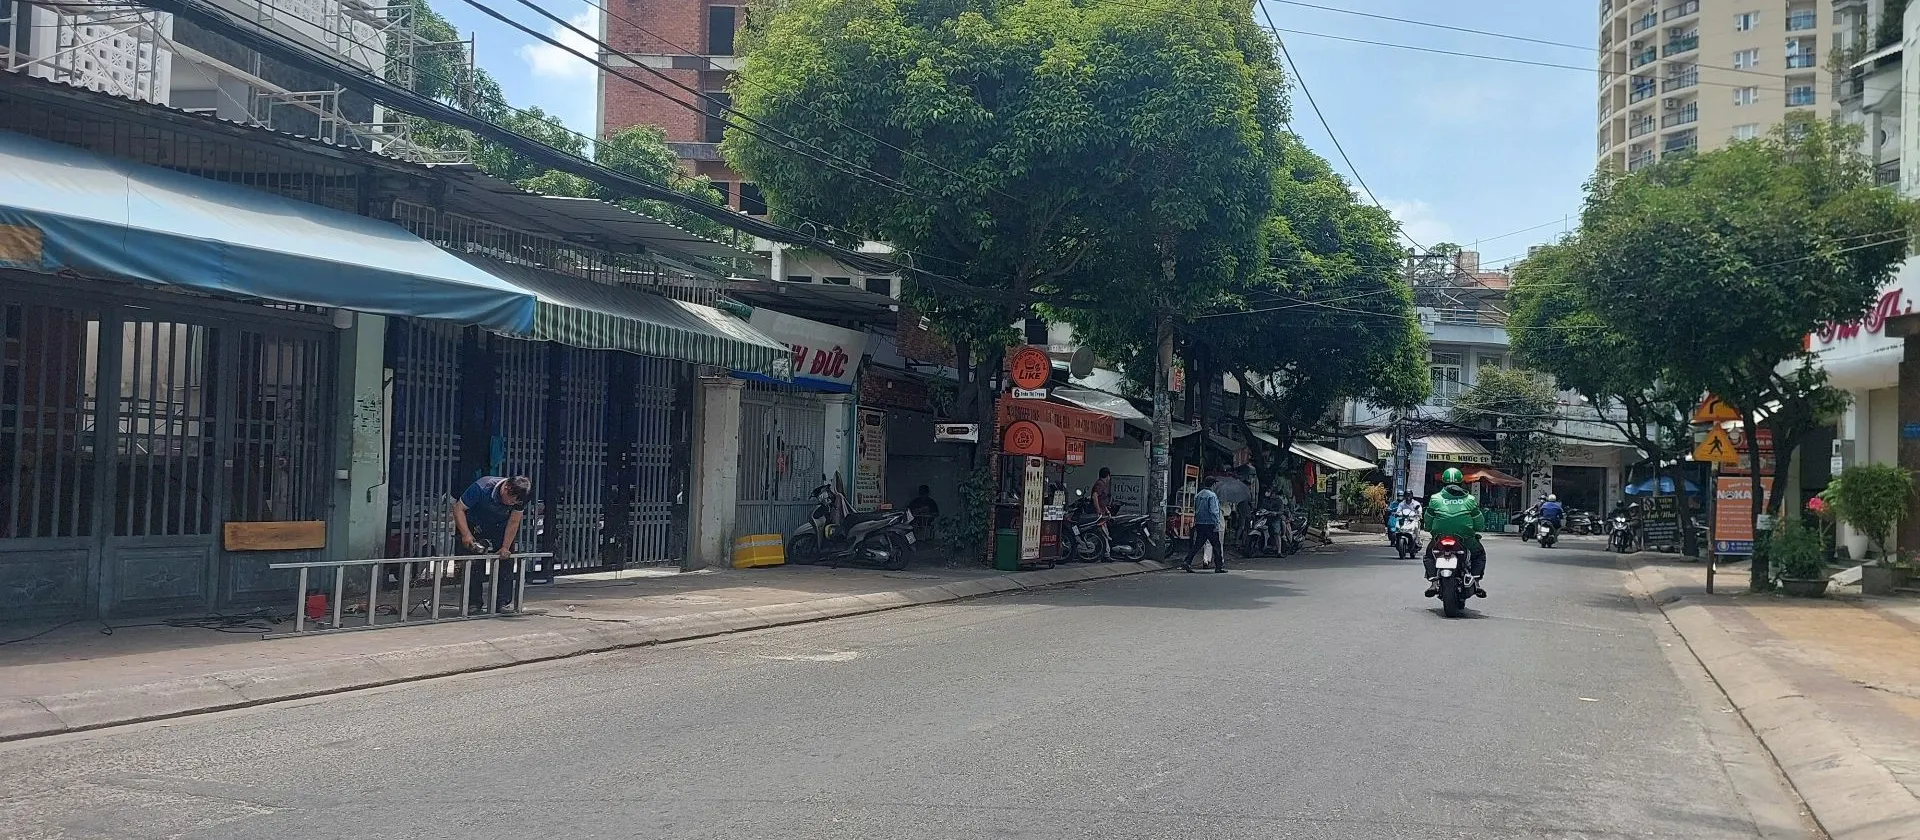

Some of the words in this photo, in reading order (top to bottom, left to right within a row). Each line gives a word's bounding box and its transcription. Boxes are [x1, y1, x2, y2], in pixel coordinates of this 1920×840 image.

[809, 345, 848, 378] ĐỨC
[1018, 370, 1041, 380] LIKE
[1014, 389, 1020, 398] 6
[1426, 452, 1439, 461] INH
